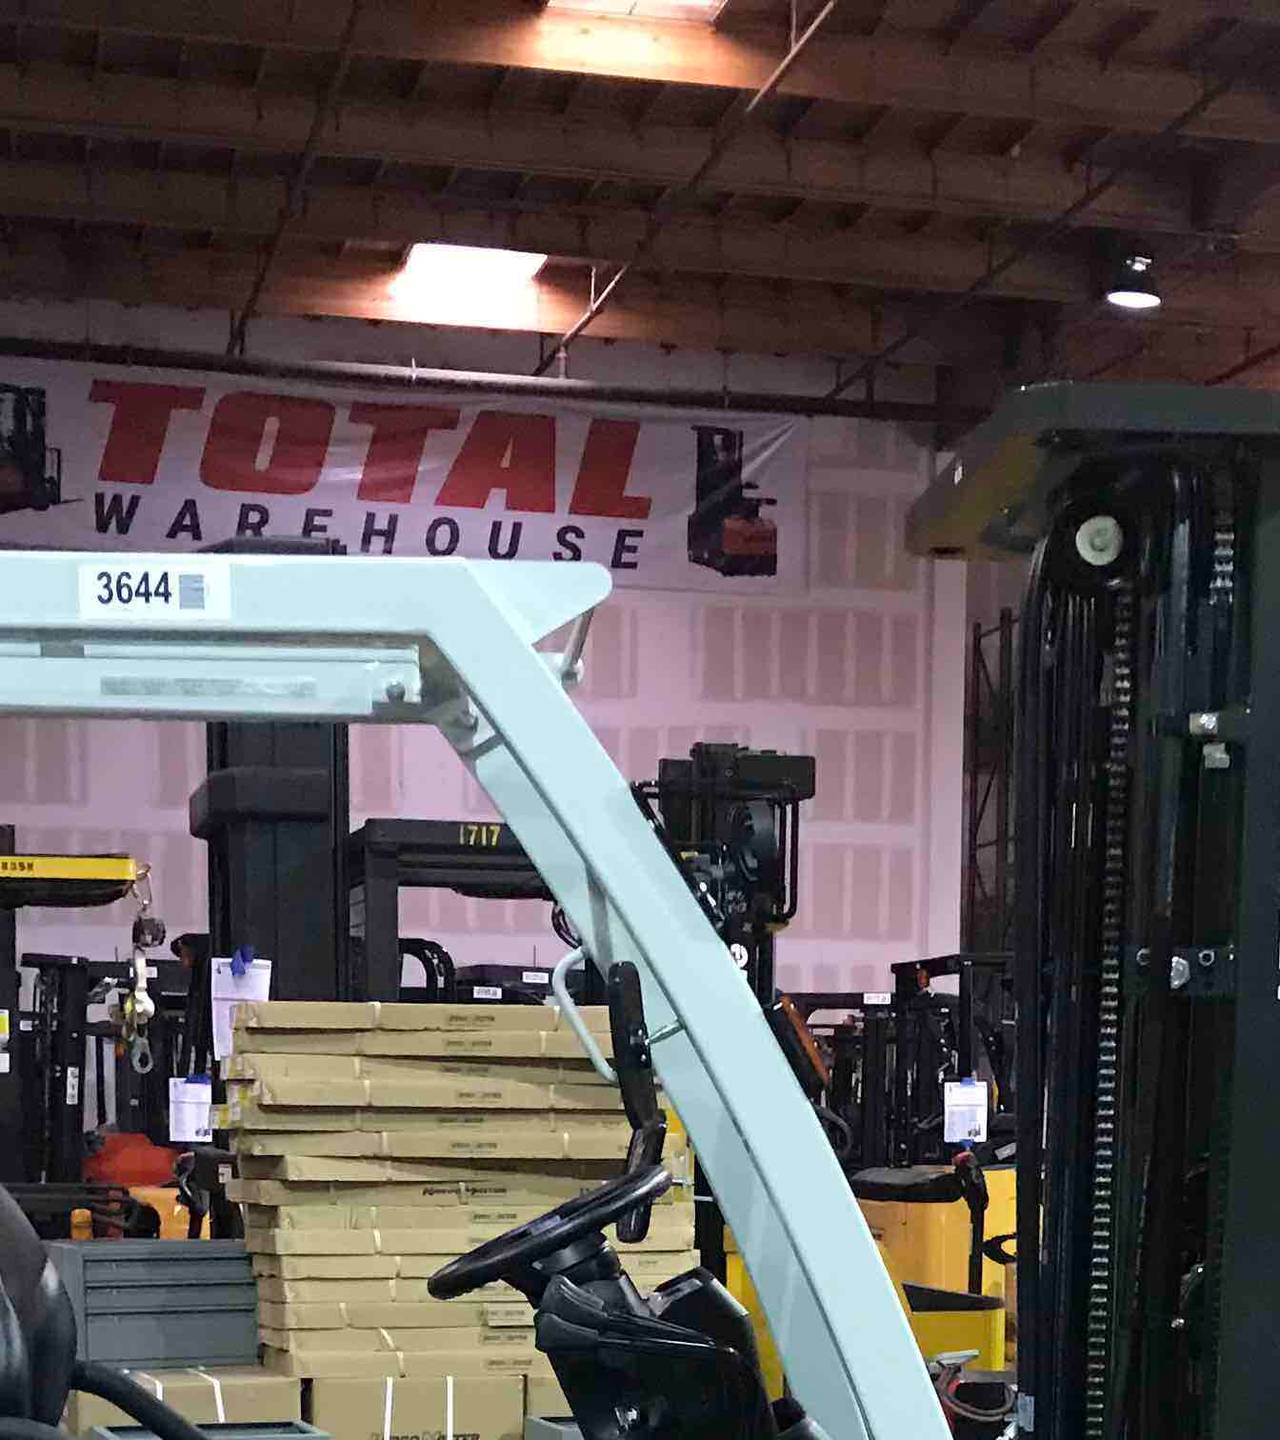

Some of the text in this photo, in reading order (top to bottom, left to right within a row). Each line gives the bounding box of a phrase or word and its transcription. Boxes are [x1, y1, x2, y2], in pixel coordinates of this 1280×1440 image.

[89, 379, 653, 519] TOTAL
[92, 492, 645, 570] WAREHOUSE
[97, 571, 172, 604] 3644
[459, 824, 501, 847] 1717
